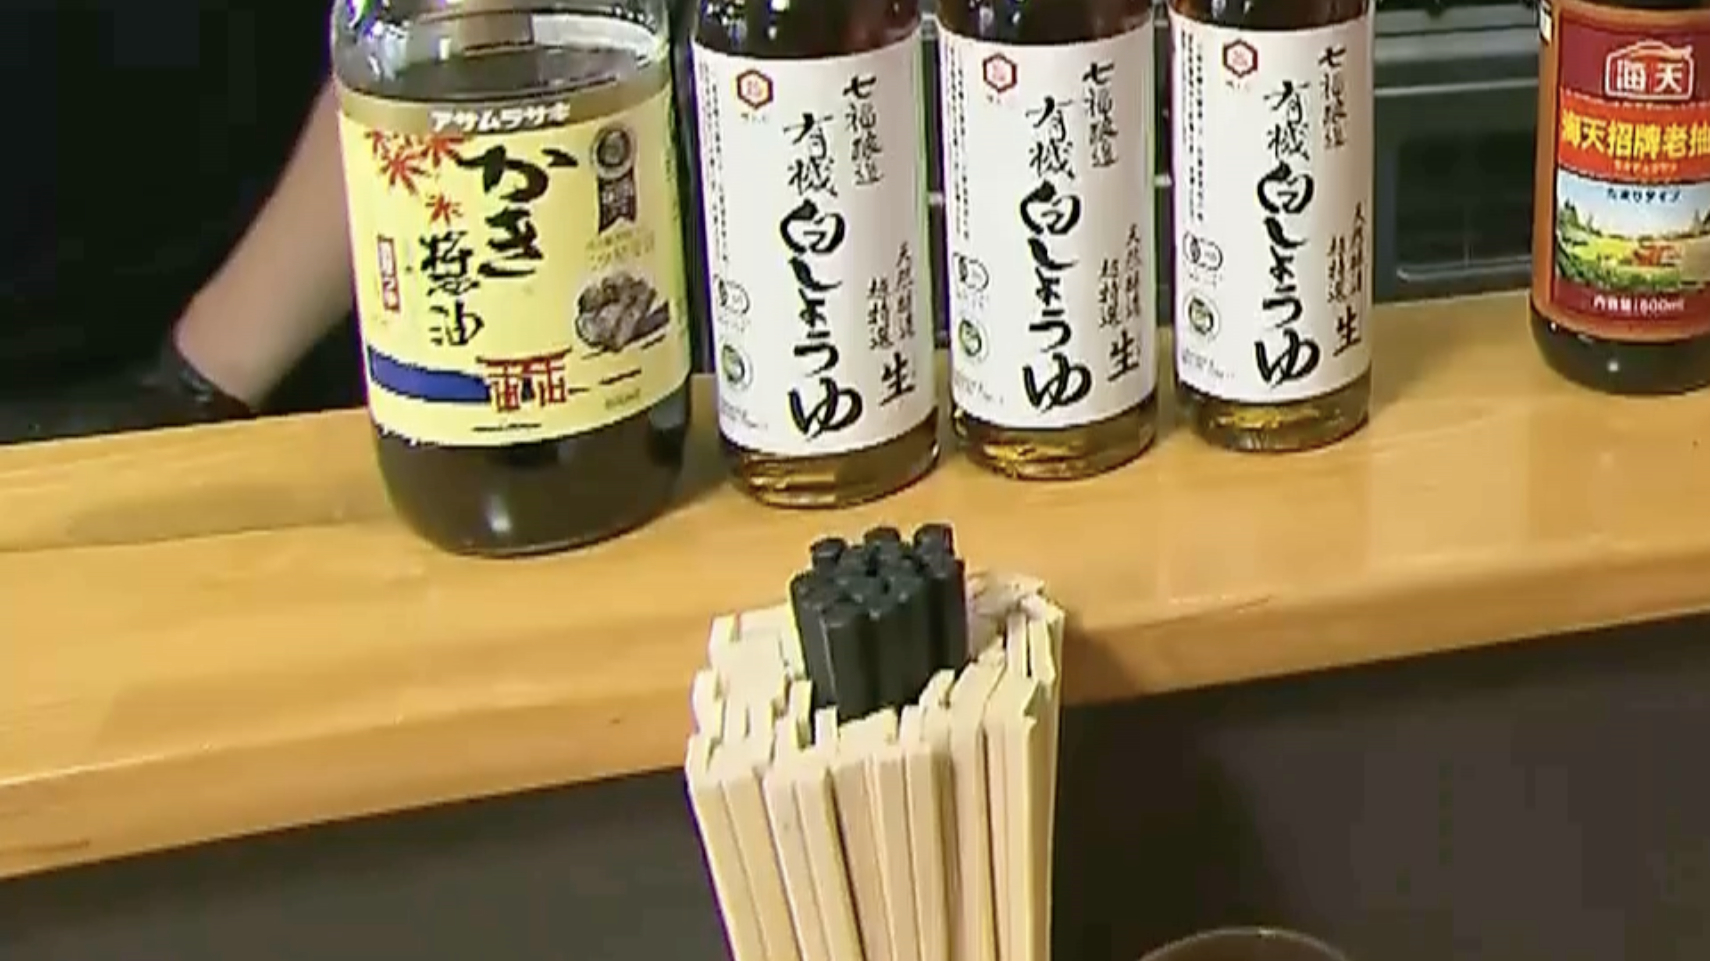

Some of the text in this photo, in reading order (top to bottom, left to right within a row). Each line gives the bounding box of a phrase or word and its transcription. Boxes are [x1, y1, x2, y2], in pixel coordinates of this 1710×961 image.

[1615, 59, 1685, 94] 海天
[430, 103, 572, 133] アサムラサキ
[1106, 329, 1141, 383] 生
[1332, 304, 1364, 359] 生
[880, 351, 917, 407] 生
